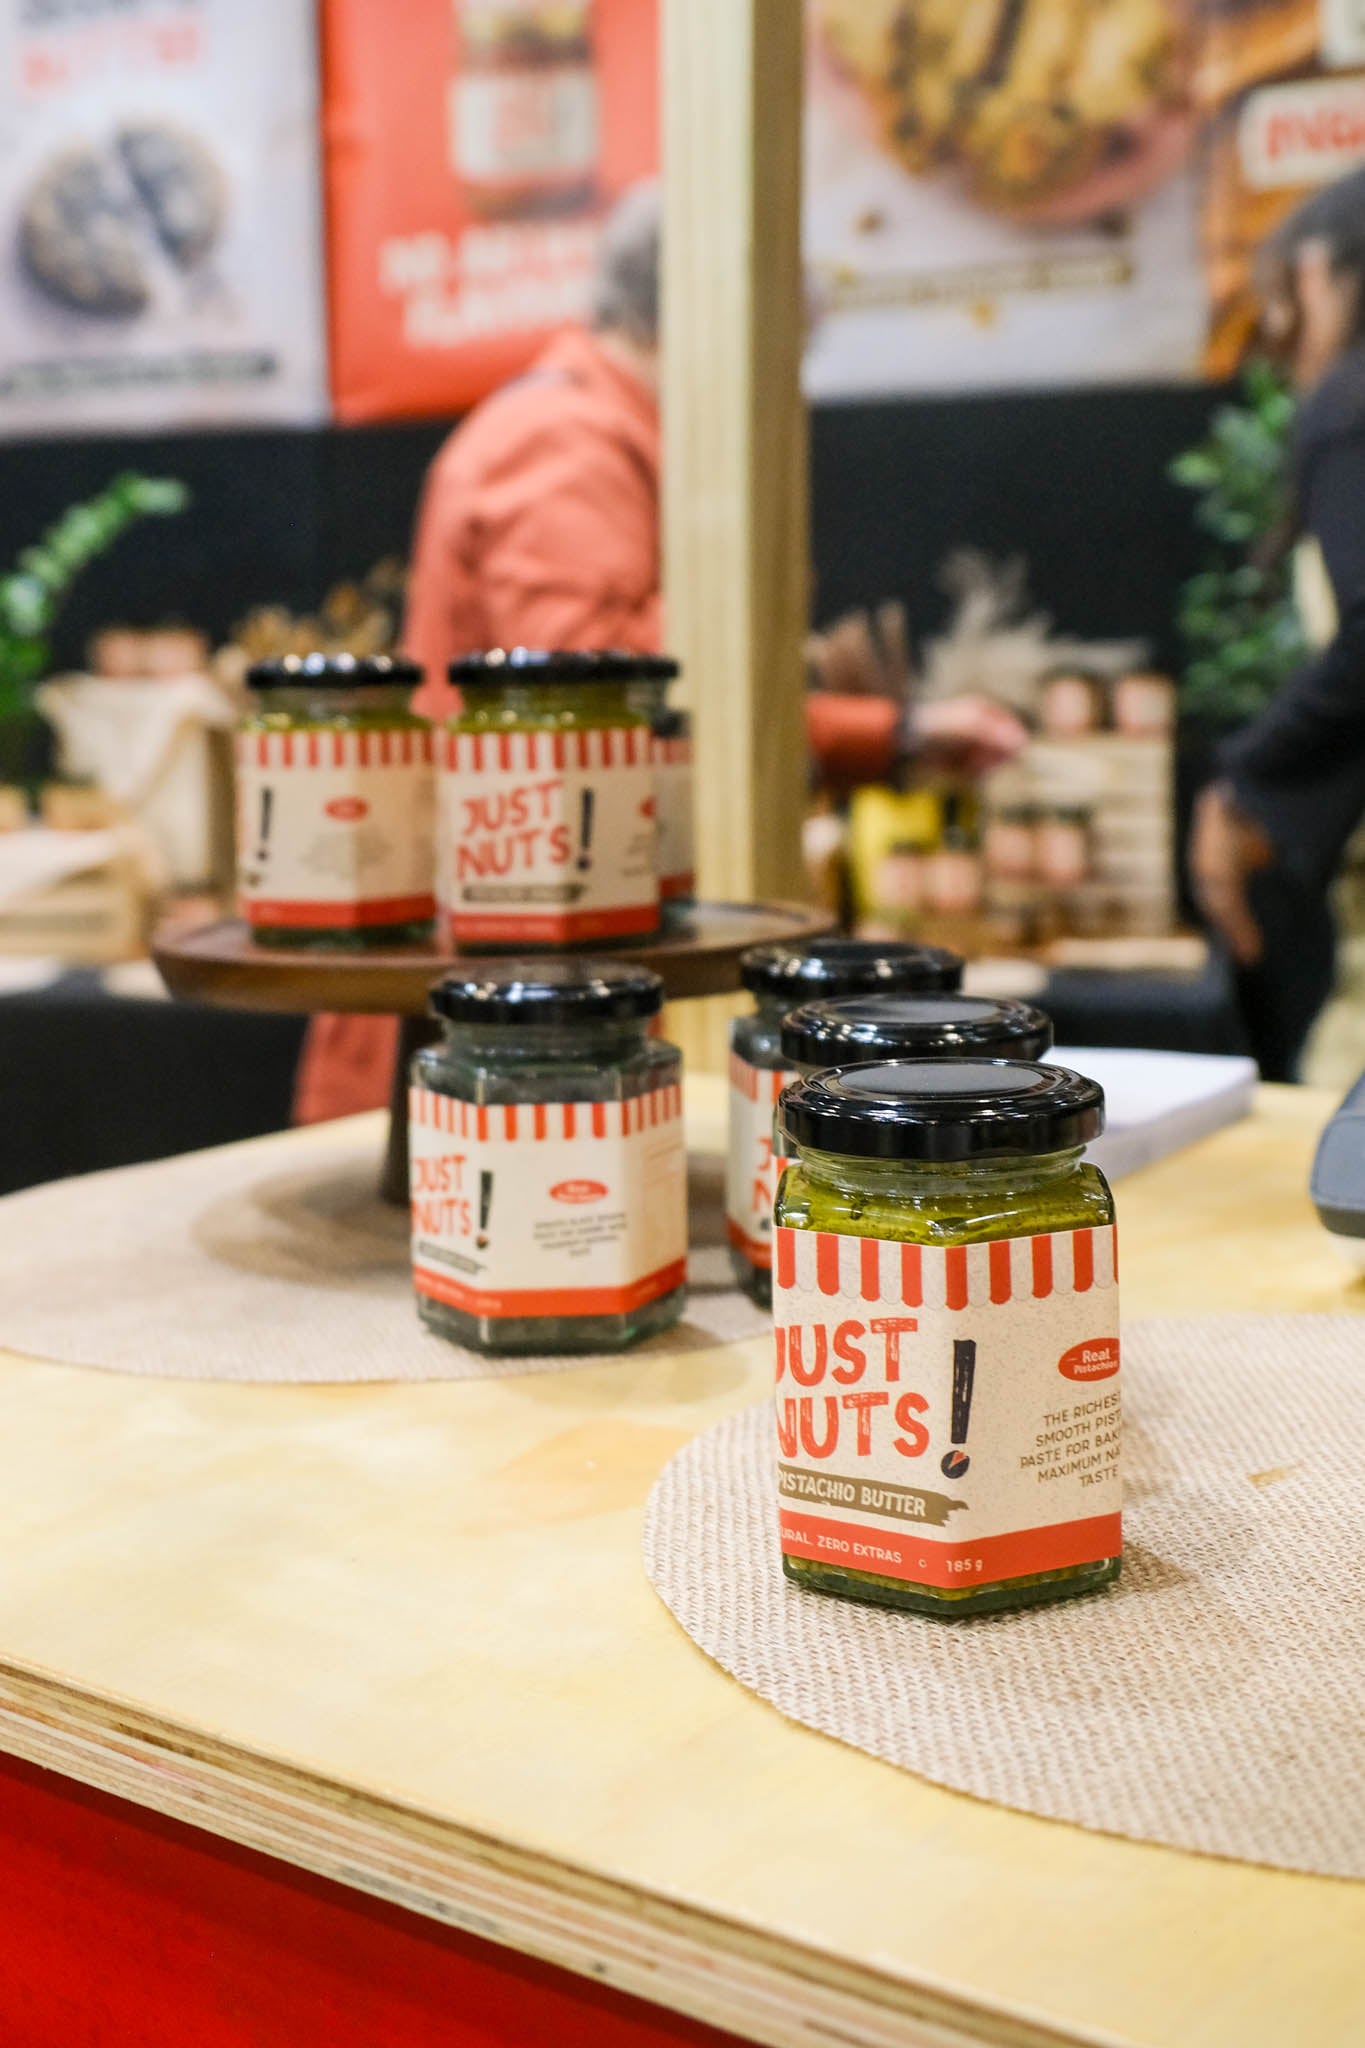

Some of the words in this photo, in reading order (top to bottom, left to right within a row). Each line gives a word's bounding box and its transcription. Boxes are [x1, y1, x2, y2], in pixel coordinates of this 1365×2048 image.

[462, 780, 563, 837] JUST
[414, 1154, 466, 1191] JUST
[1082, 1348, 1110, 1364] Real
[1043, 1409, 1069, 1426] THE
[1036, 1422, 1091, 1447] SMOOTH
[1020, 1448, 1061, 1468] PASTE
[1066, 1440, 1090, 1457] FOR
[1038, 1455, 1101, 1483] MAXIMUM
[1080, 1464, 1118, 1488] TASTE
[861, 1486, 926, 1517] BUTTER
[818, 1536, 849, 1553] ZERO
[853, 1543, 902, 1564] EXTRAS
[946, 1559, 972, 1573] 185
[975, 1559, 983, 1572] g
